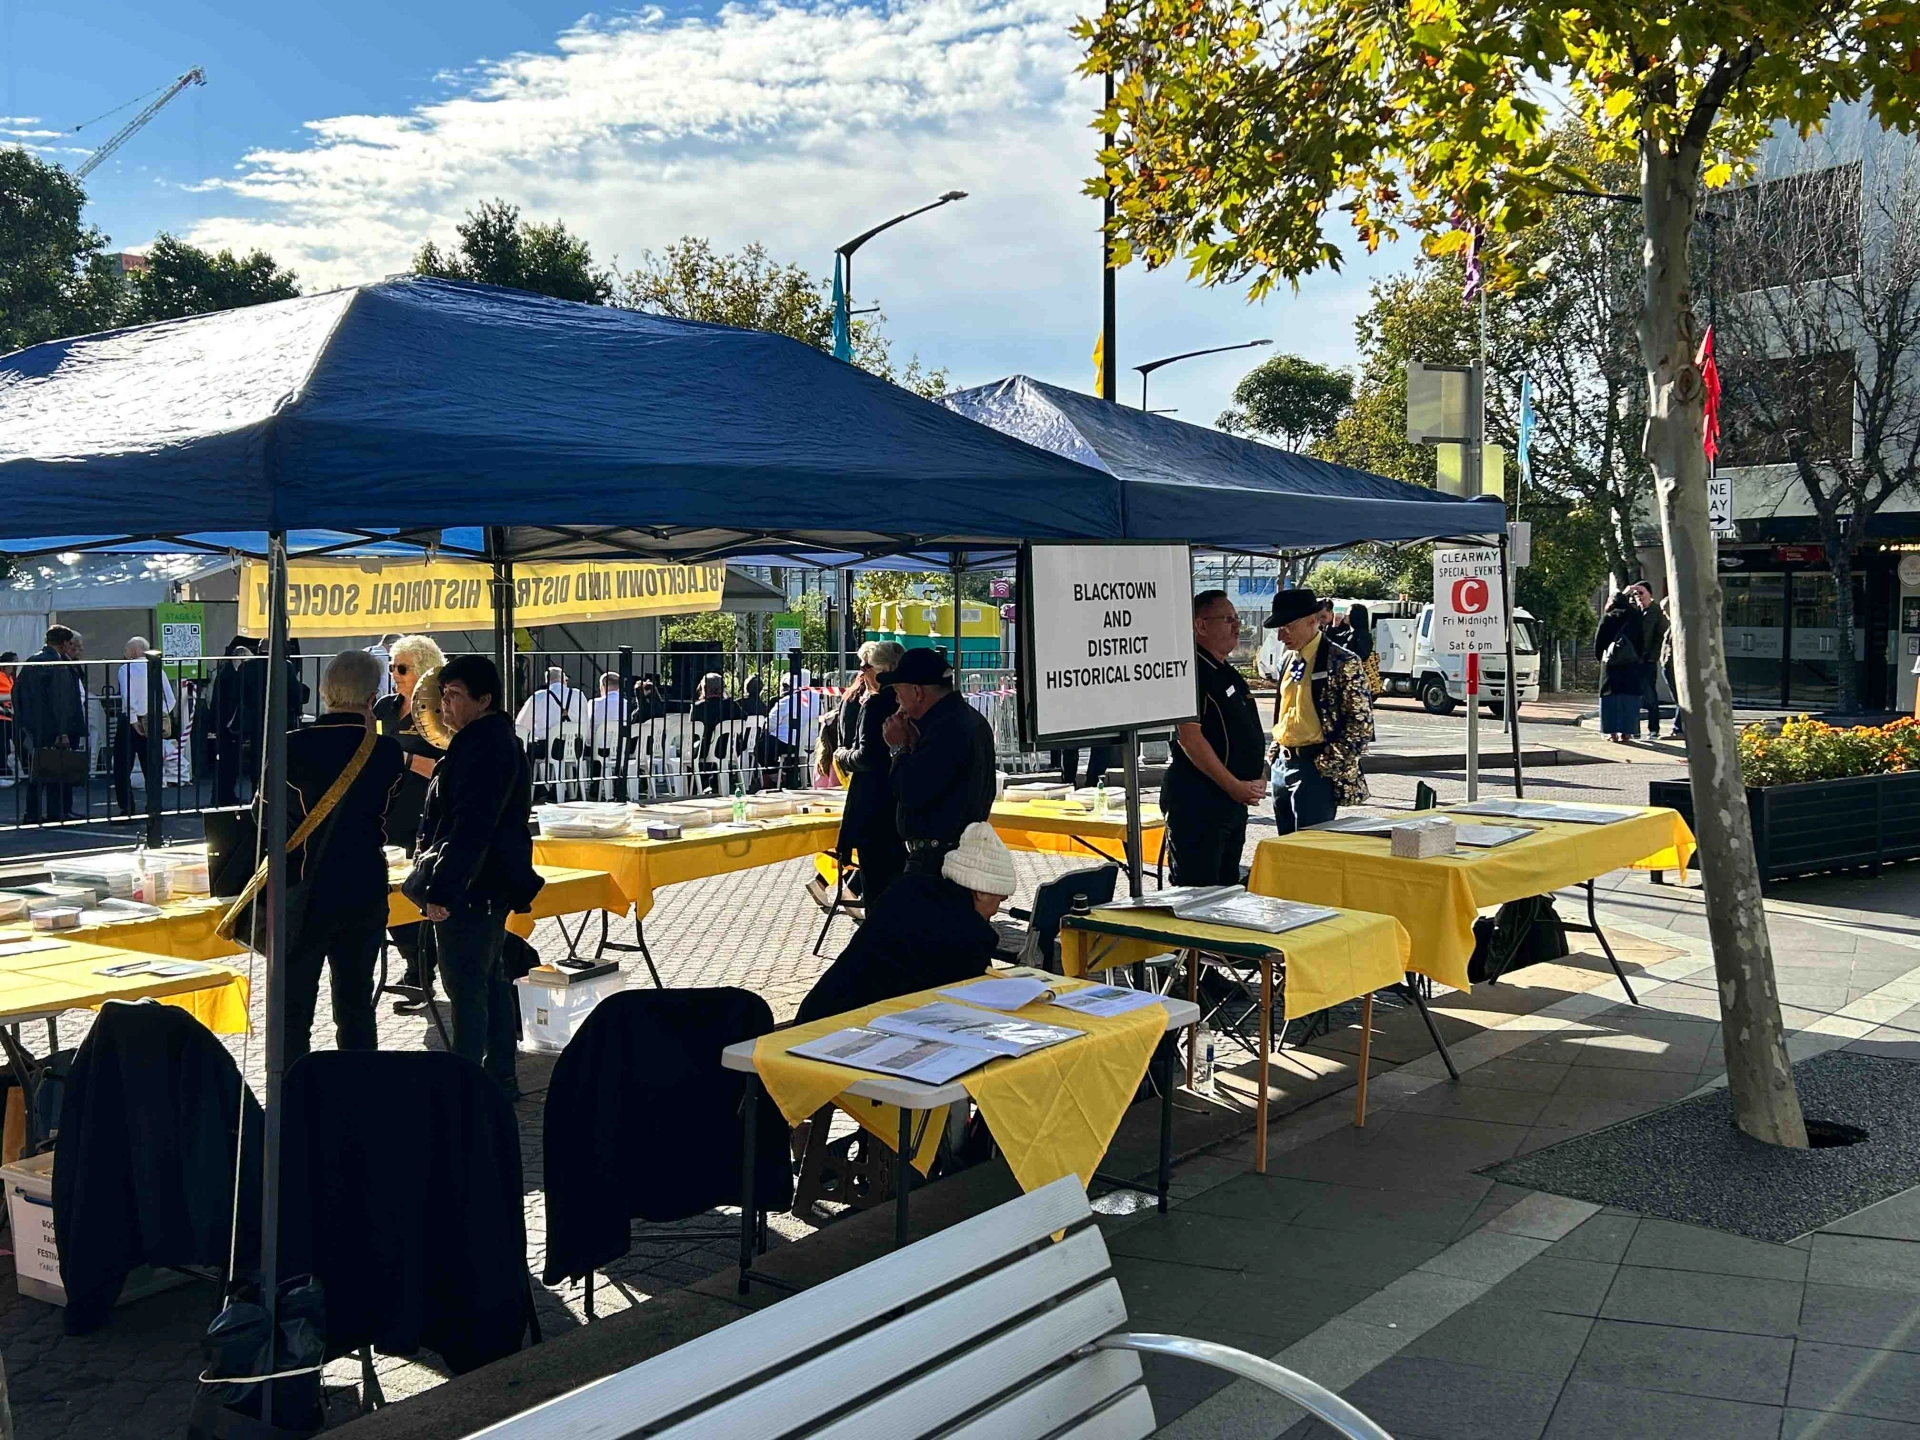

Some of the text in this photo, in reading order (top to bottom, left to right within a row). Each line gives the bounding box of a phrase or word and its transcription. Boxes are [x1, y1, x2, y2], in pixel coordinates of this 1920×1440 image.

[1710, 484, 1727, 495] NE
[1710, 499, 1728, 511] AY
[1441, 551, 1499, 563] CLEARWAY
[1439, 565, 1502, 578] SPECIAL EVENTS
[1073, 581, 1157, 601] BLACKTOWN
[1460, 580, 1480, 612] C
[1103, 610, 1132, 628] AND
[1442, 616, 1498, 627] Fri Midnight
[1465, 629, 1475, 638] to
[1088, 636, 1149, 657] DISTRICT
[1449, 641, 1492, 651] Sat 6 pm
[1046, 660, 1188, 689] HISTORICAL SOCIETY
[42, 1219, 55, 1230] BOO
